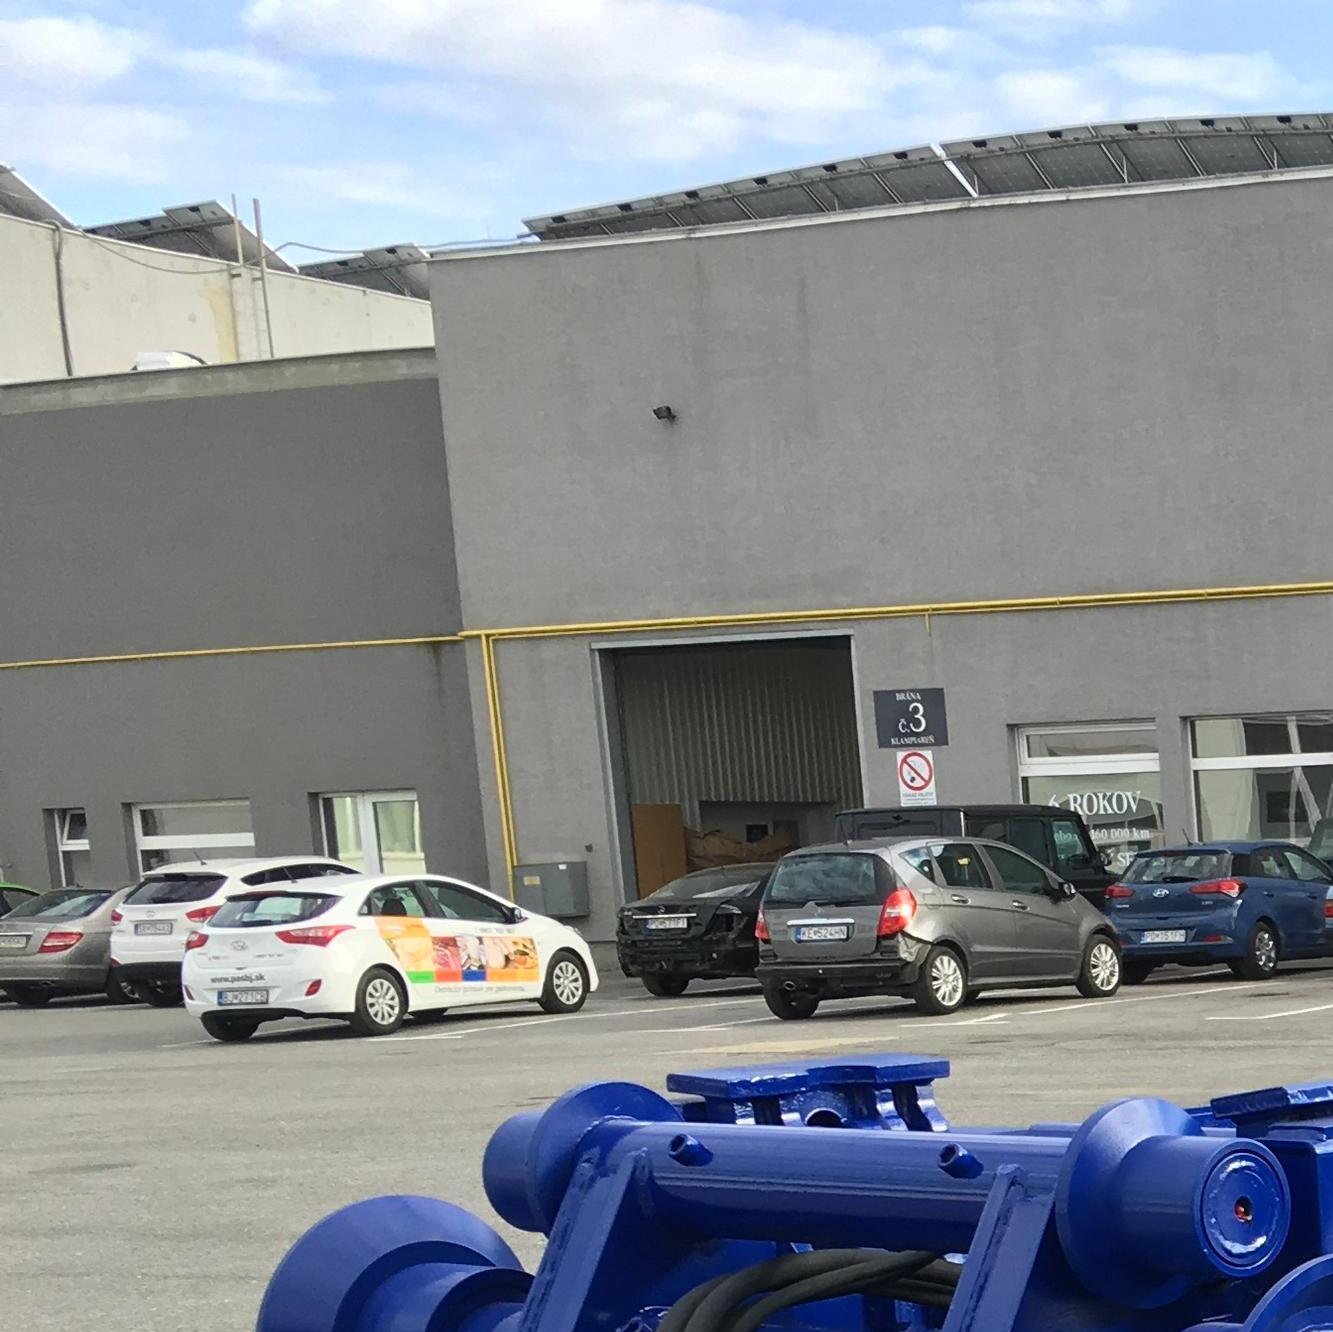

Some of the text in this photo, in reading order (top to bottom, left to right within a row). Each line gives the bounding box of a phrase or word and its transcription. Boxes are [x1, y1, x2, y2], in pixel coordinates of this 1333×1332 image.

[896, 691, 921, 701] BRÁNA
[1067, 790, 1142, 816] ROKOV
[1131, 827, 1150, 839] km
